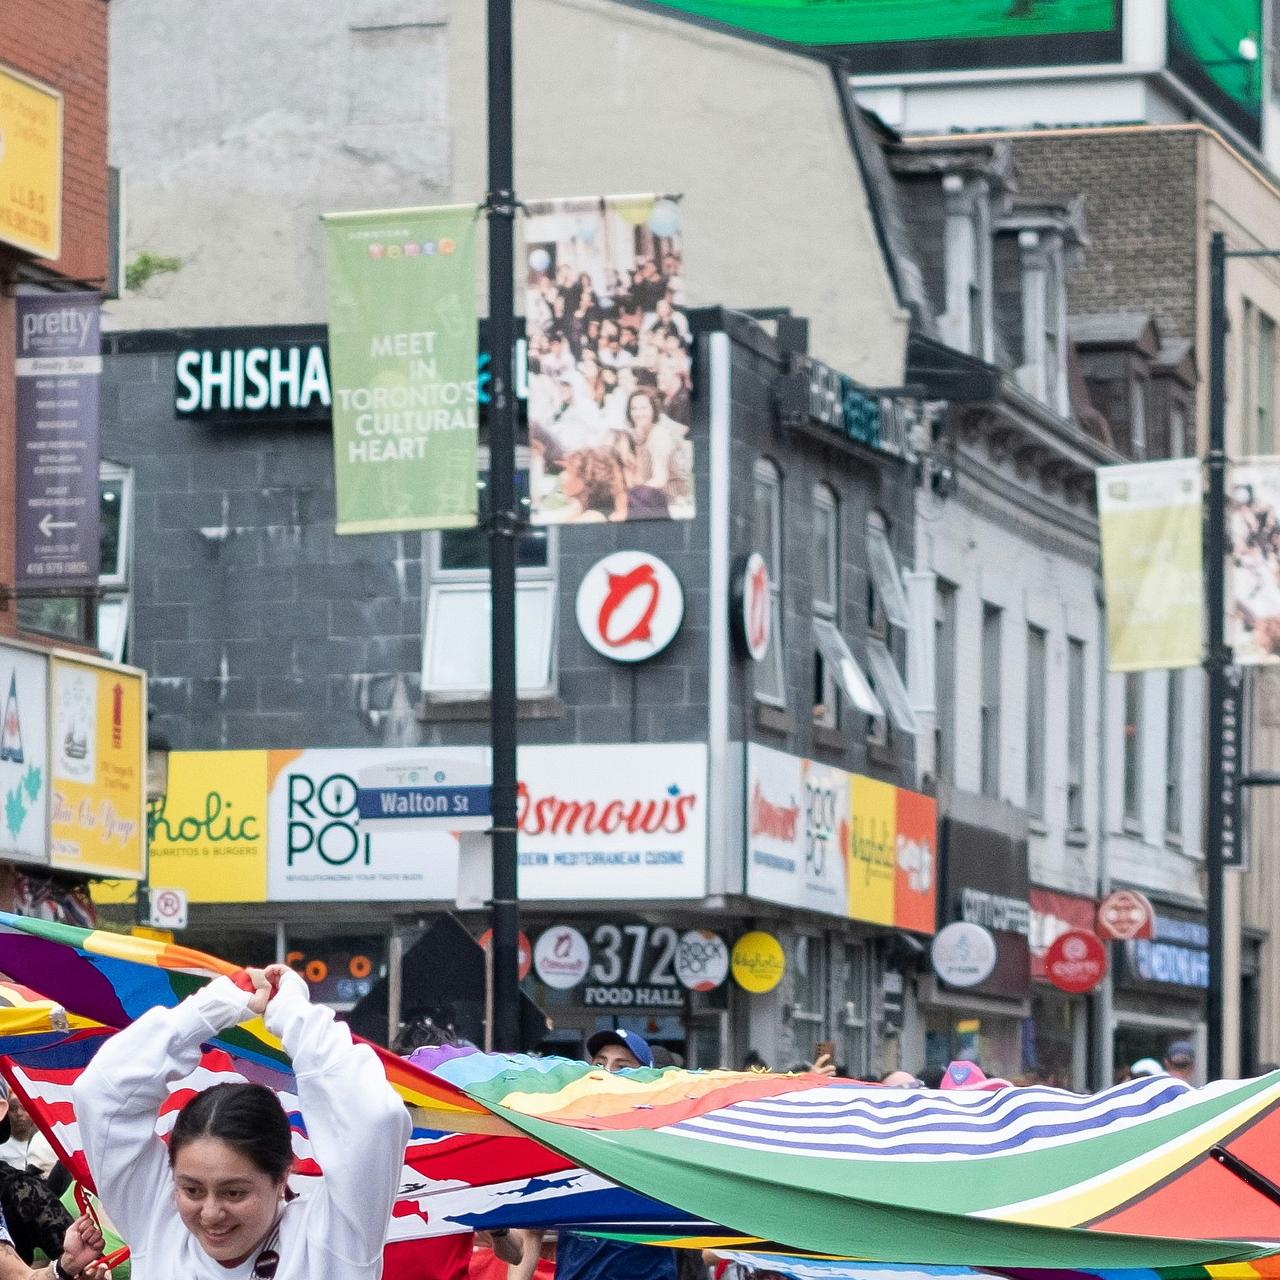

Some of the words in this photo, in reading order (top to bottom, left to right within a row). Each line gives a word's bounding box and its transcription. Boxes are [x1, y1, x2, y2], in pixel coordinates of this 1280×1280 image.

[22, 306, 96, 351] pretty
[370, 331, 437, 358] MEET
[175, 346, 332, 414] SHISHA
[410, 357, 437, 379] IN
[338, 379, 478, 412] TORONTO'S
[355, 407, 478, 436] CULTURAL
[348, 436, 429, 464] HEART
[380, 790, 449, 814] Walton
[453, 795, 469, 812] St
[149, 847, 199, 858] BURRITOS
[213, 846, 258, 857] BURGERS
[593, 924, 677, 985] 372
[585, 987, 633, 1005] FOOD
[636, 986, 683, 1005] HALL
